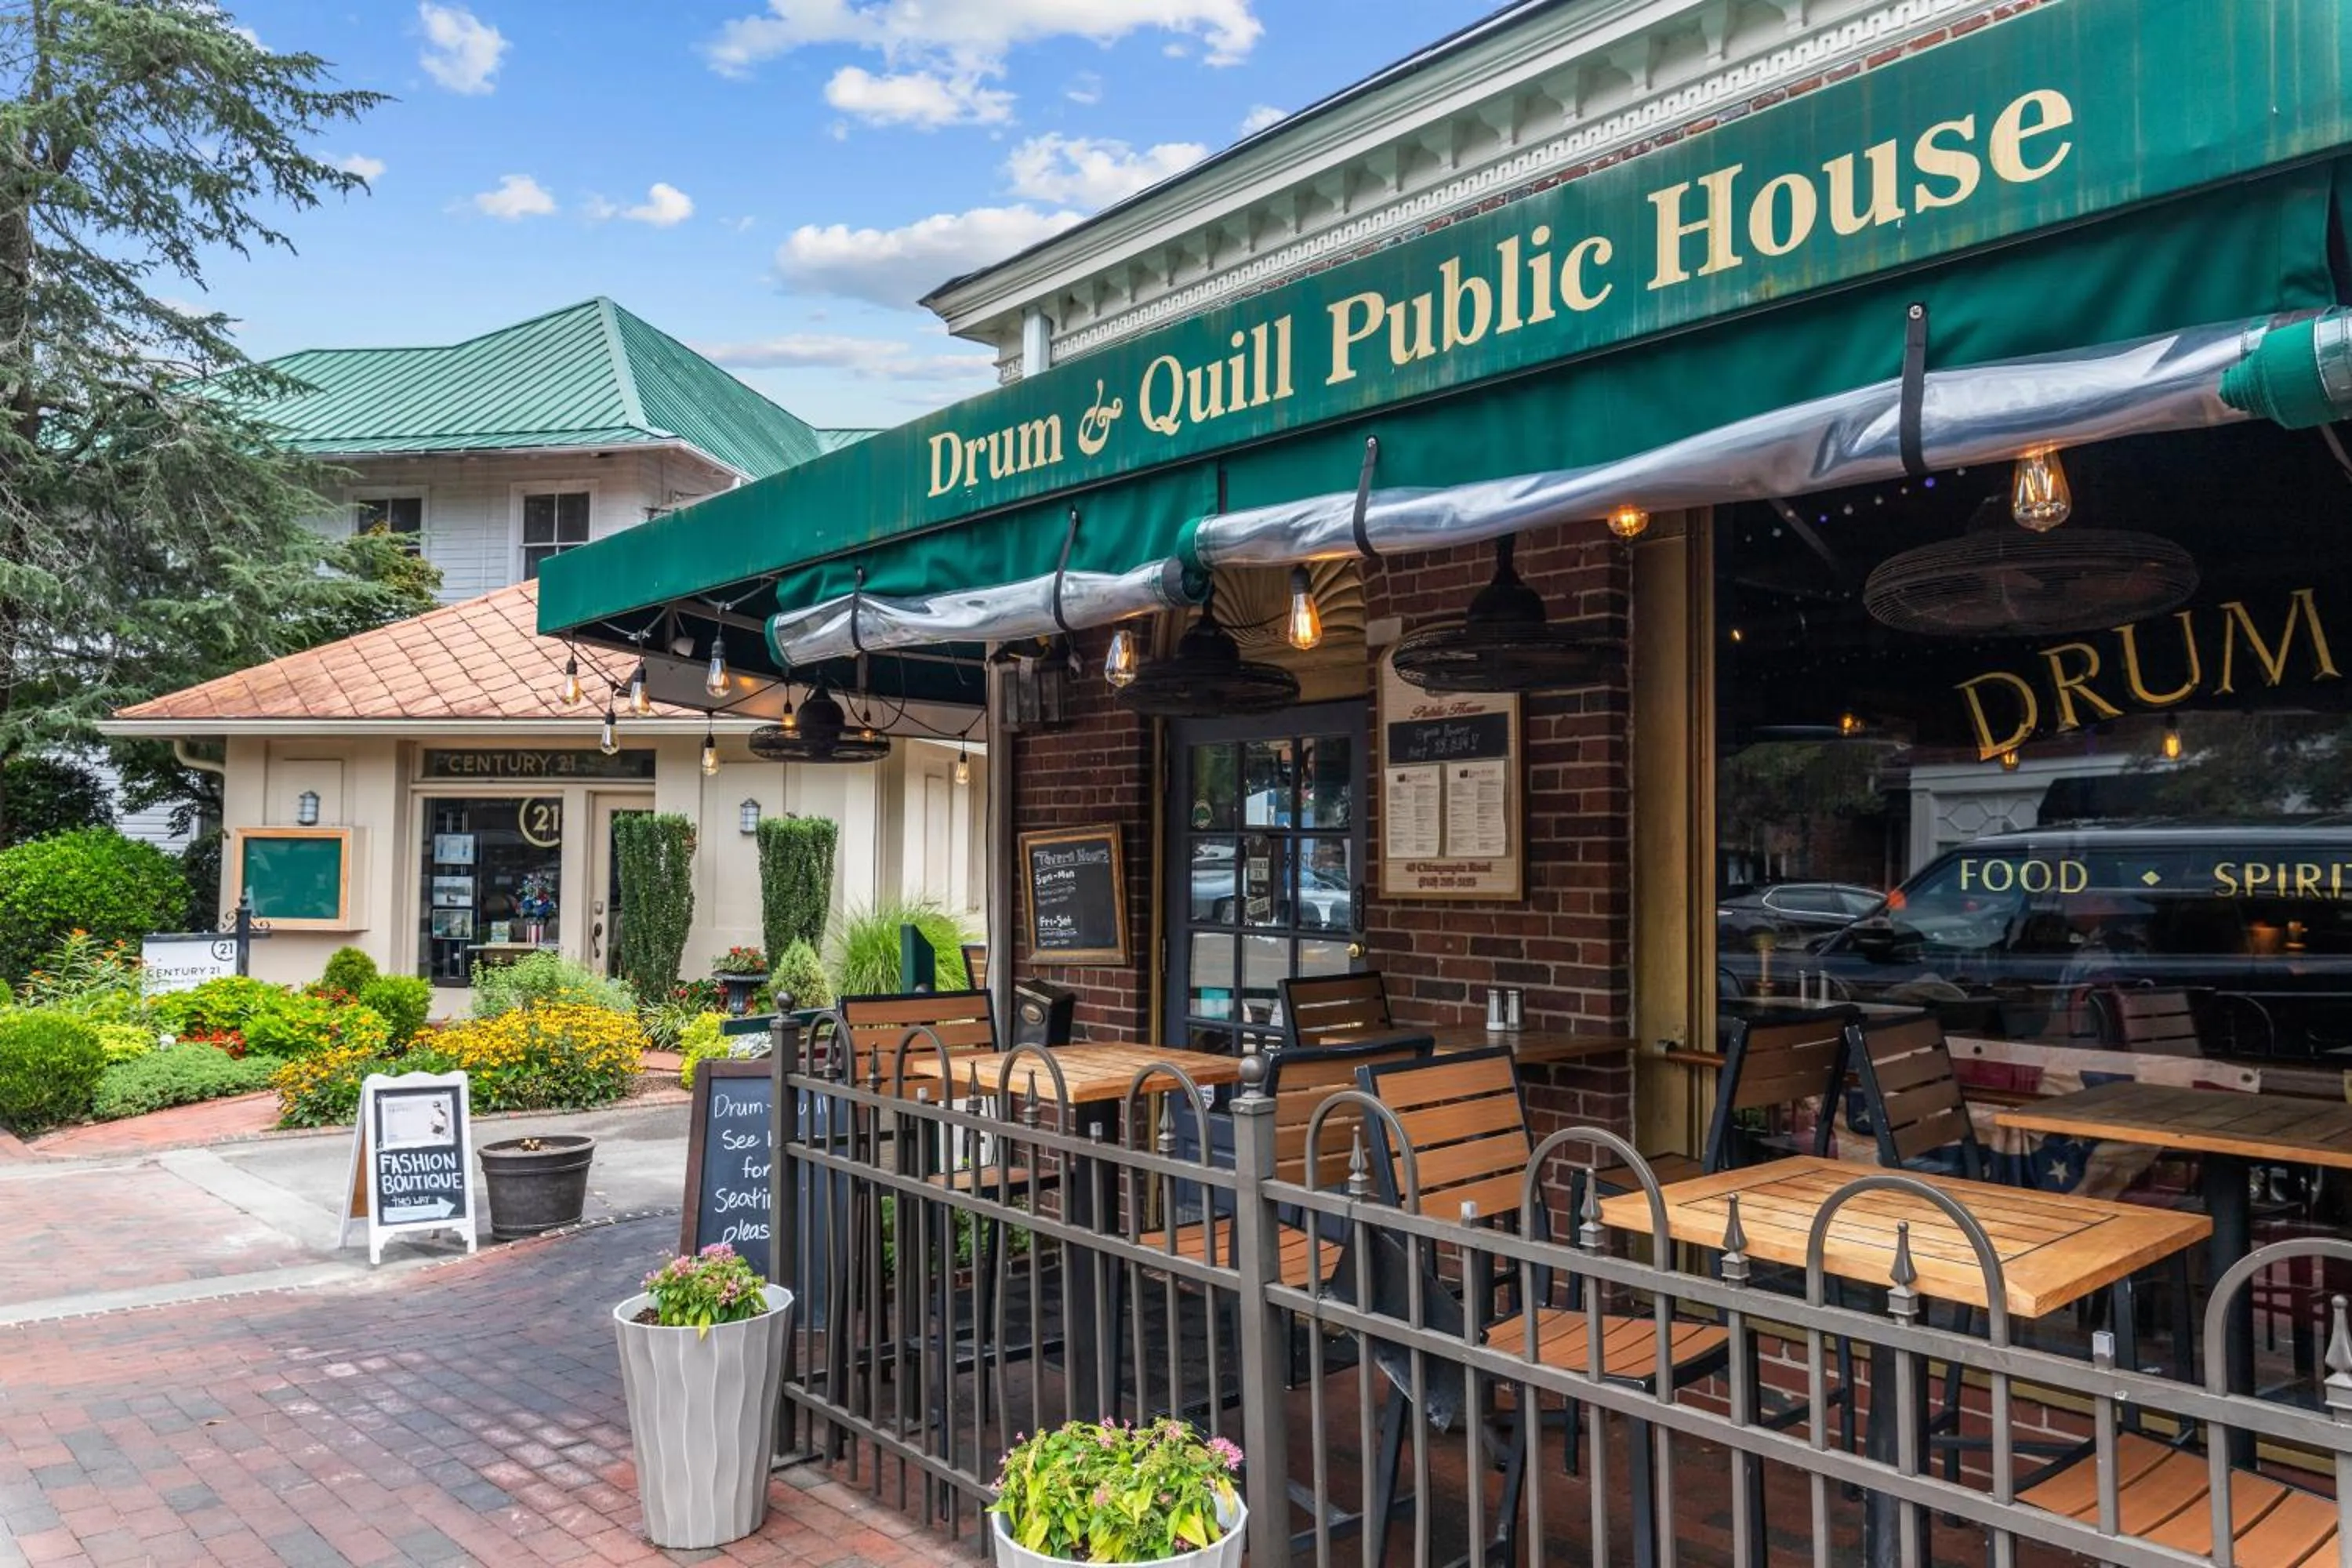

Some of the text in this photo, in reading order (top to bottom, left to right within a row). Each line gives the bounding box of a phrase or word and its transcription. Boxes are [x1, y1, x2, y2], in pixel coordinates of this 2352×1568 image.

[927, 88, 2073, 499] Drum & Quill Public House
[1954, 587, 2343, 763] DRUM
[448, 754, 576, 773] CENTURY 21
[532, 804, 560, 832] 21
[1961, 859, 2089, 894] FOOD
[219, 942, 234, 955] 21
[146, 966, 221, 978] CENTURY 21
[721, 1129, 760, 1151] See
[379, 1152, 457, 1174] FASHION
[742, 1156, 772, 1179] for
[381, 1172, 463, 1195] BOUTIQUE
[722, 1218, 771, 1247] pleas
